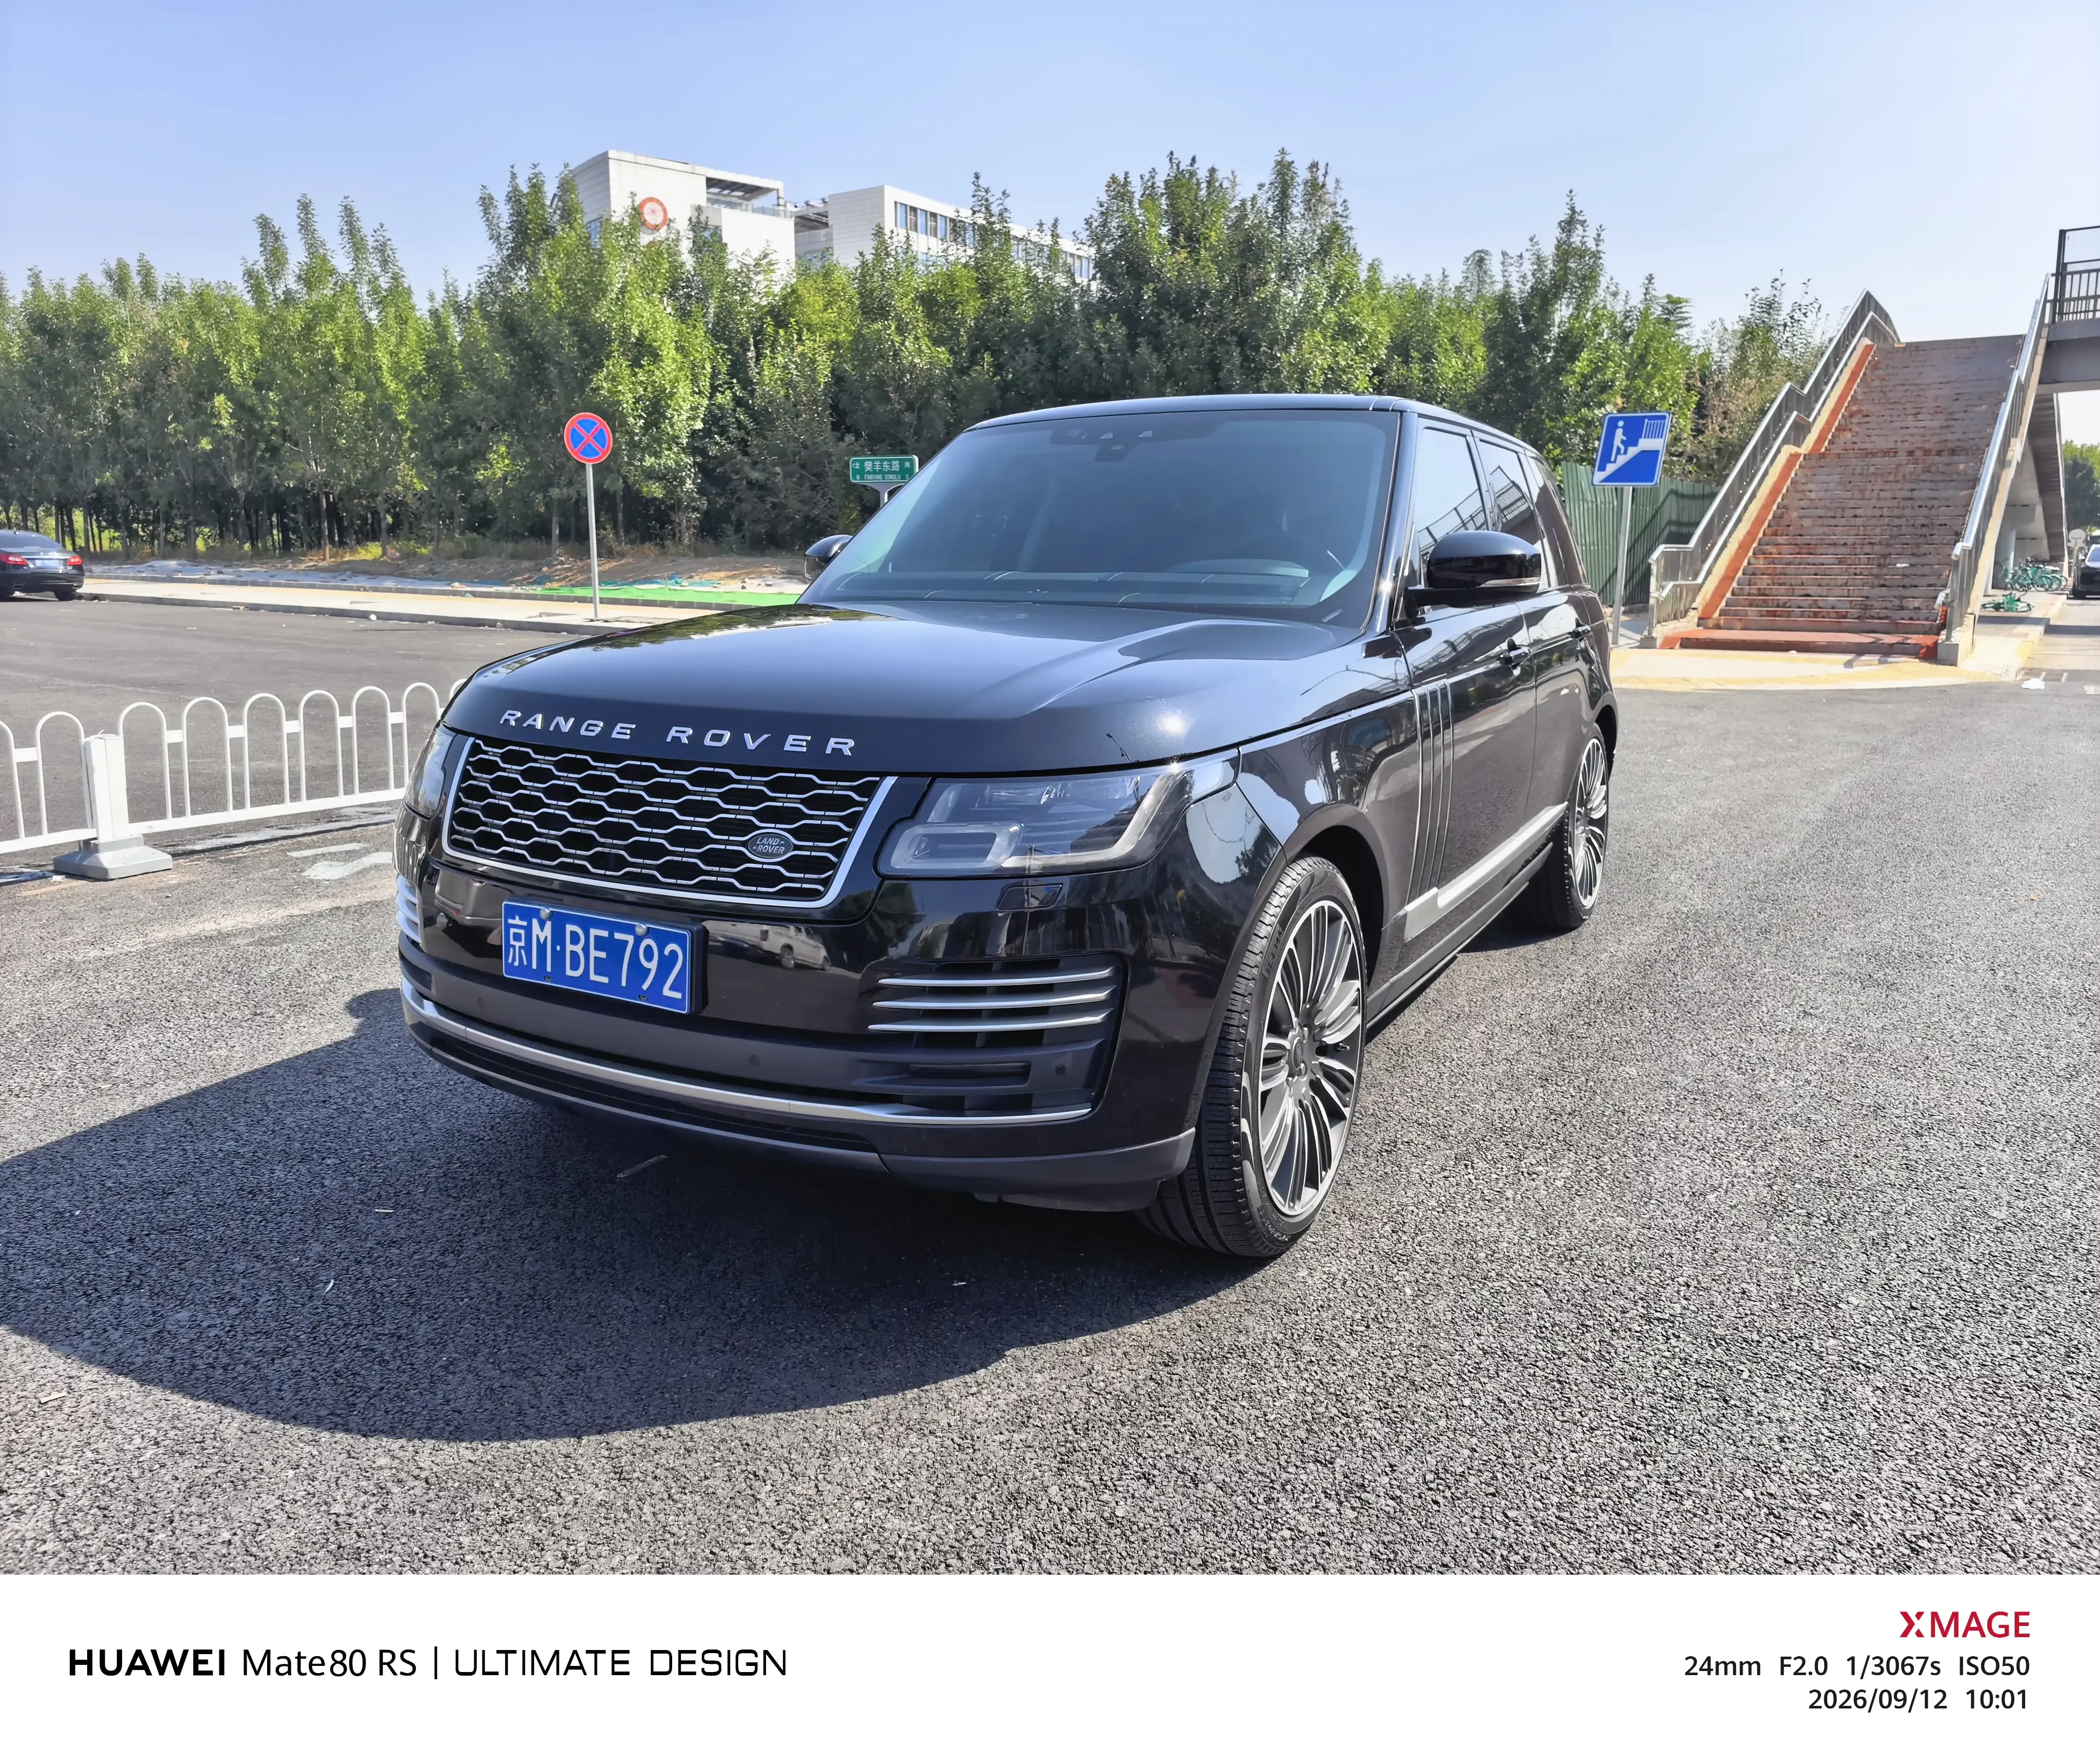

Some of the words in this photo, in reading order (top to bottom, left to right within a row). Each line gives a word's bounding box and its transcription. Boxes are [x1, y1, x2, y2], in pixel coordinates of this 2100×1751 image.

[864, 460, 900, 472] 樊羊东路
[500, 709, 636, 740] RANGE
[667, 726, 856, 756] ROVER
[756, 837, 780, 845] LAND
[756, 845, 785, 854] ROVER
[507, 915, 683, 1000] 京M·BE792
